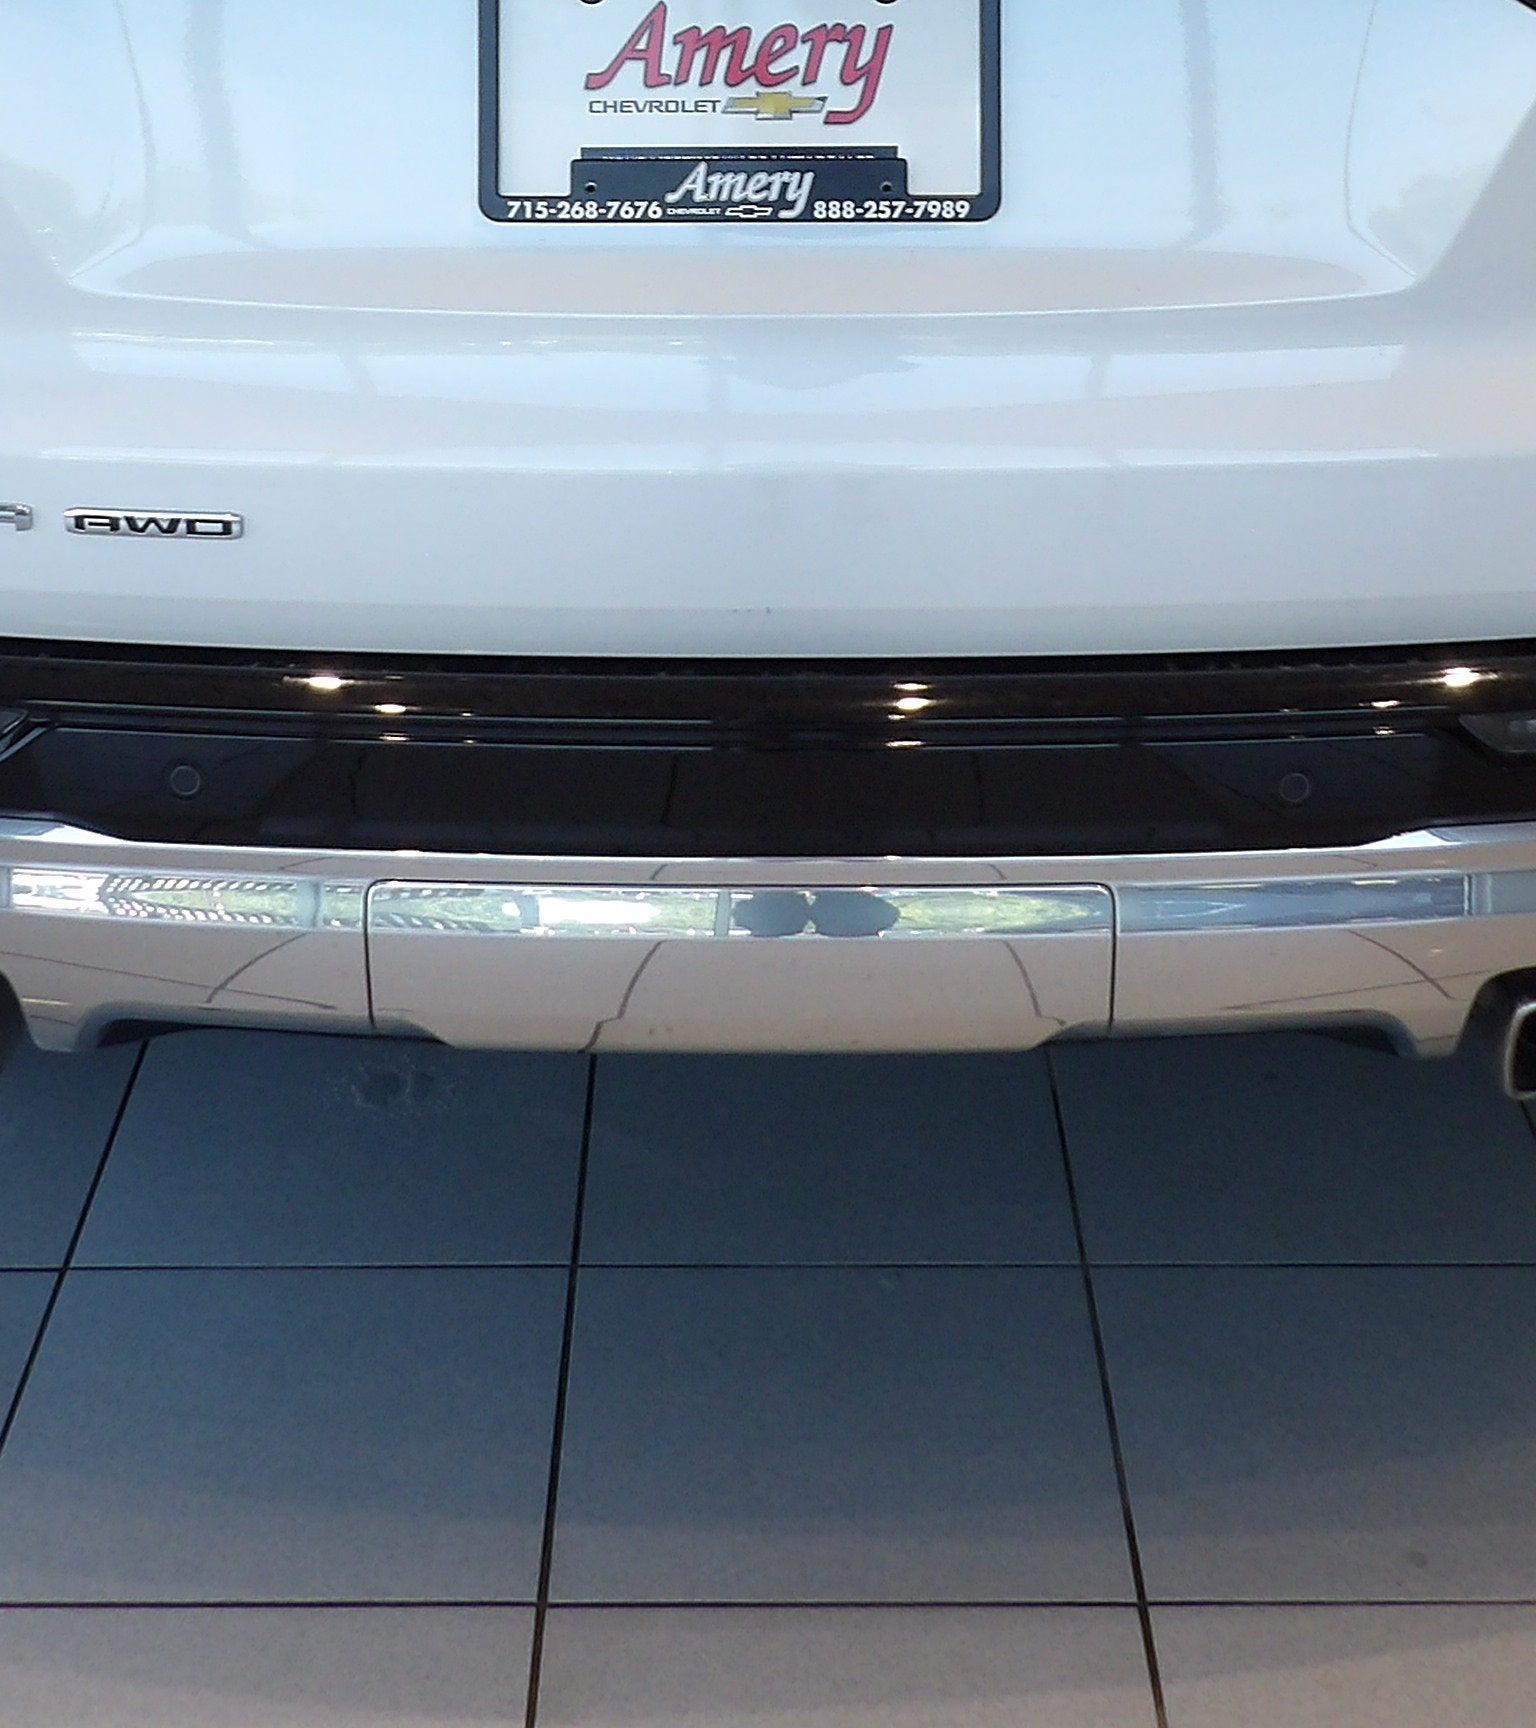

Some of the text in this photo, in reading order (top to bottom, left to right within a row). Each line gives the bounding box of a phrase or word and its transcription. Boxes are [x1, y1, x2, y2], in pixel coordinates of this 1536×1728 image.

[584, 0, 894, 126] Amery
[588, 98, 721, 114] CHEVROLET
[664, 161, 815, 218] Amery
[507, 201, 663, 219] 715-268-7676
[666, 207, 721, 215] CHEVROLET
[813, 201, 970, 219] 888-257-7989
[71, 512, 236, 538] AWD
